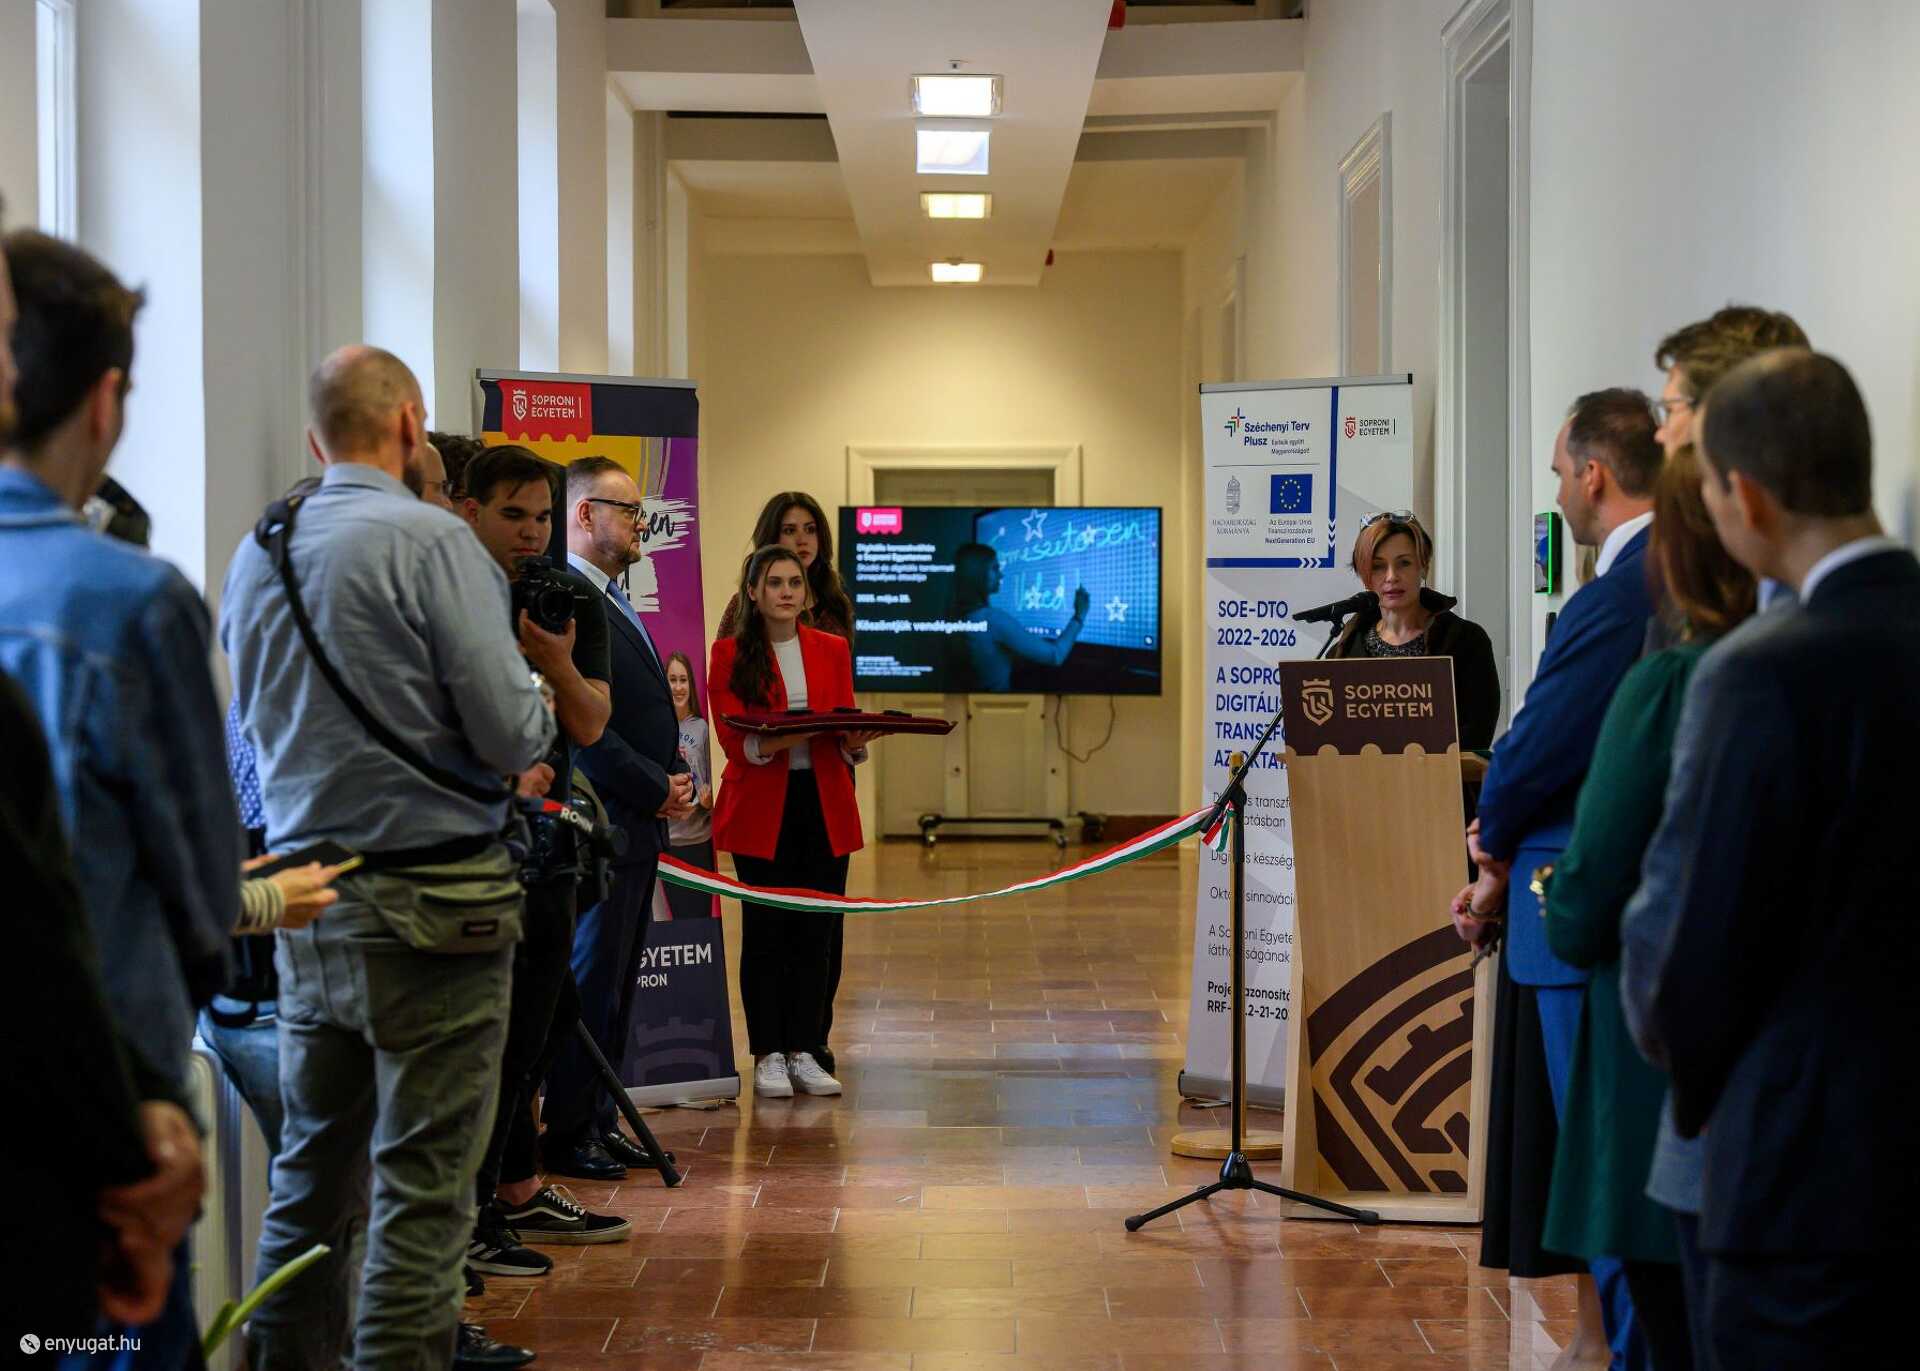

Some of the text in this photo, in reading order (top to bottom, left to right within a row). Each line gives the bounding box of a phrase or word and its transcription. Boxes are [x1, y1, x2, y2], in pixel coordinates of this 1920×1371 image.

[531, 394, 574, 406] SOPRONI
[531, 407, 575, 418] EGYETEM
[1244, 421, 1311, 433] Széchenyi Terv
[1359, 419, 1390, 427] SOPRONI
[1359, 428, 1390, 436] EGYETEM
[1244, 436, 1268, 446] Plusz
[1218, 601, 1288, 618] SOE-DTO
[1217, 628, 1296, 646] 2022-2026
[1216, 666, 1226, 684] A
[1344, 684, 1432, 700] SOPRONI
[1216, 691, 1281, 713] DIGITÁLI
[1346, 703, 1433, 718] EGYETEM
[1253, 852, 1295, 869] készség
[1209, 924, 1216, 937] A
